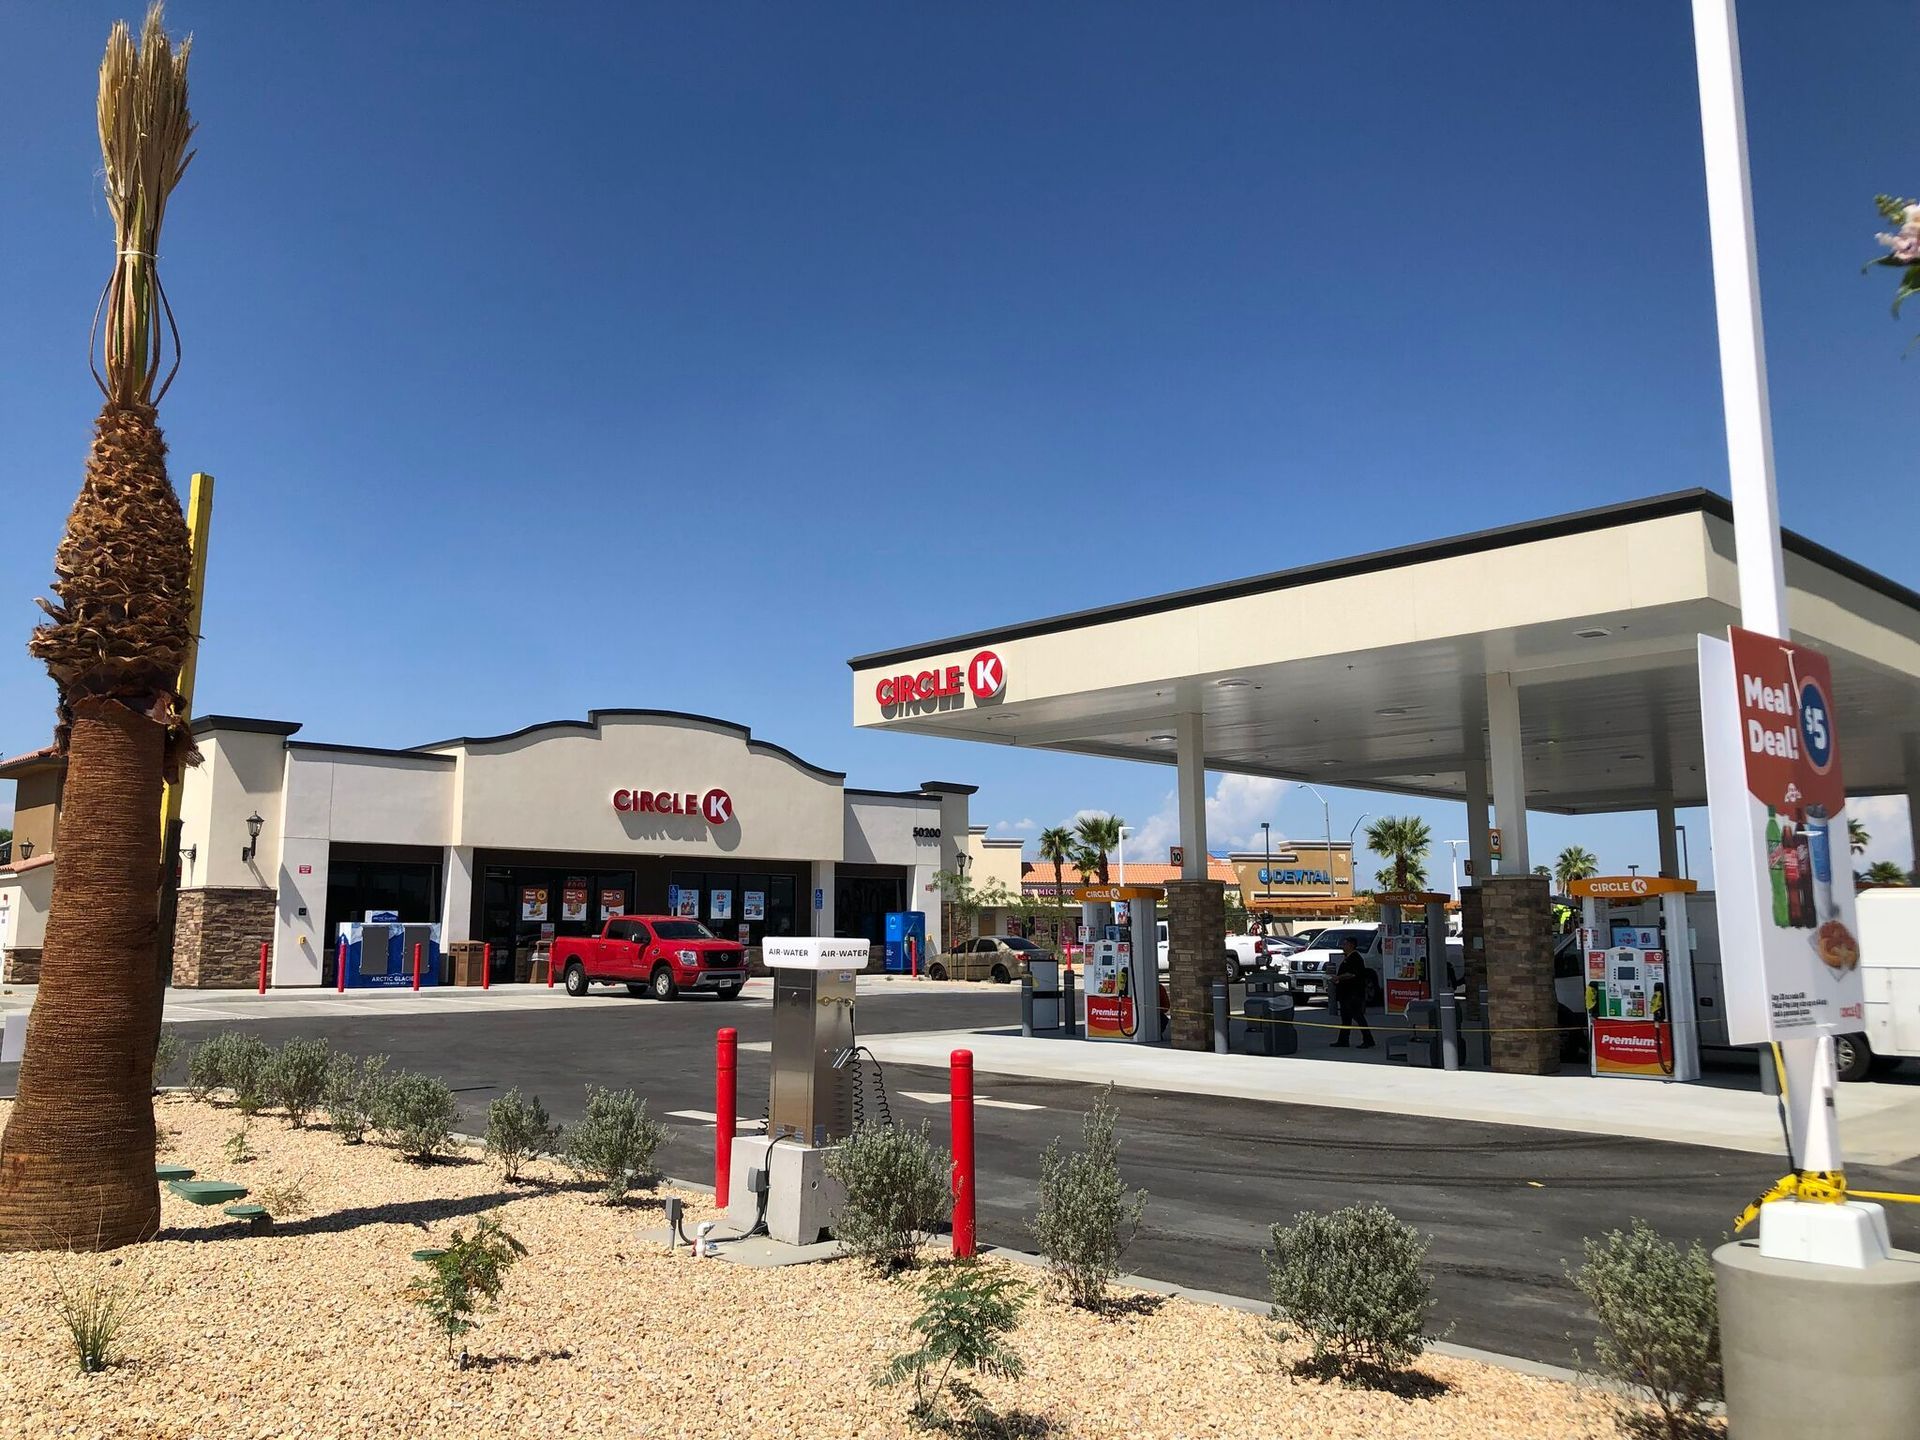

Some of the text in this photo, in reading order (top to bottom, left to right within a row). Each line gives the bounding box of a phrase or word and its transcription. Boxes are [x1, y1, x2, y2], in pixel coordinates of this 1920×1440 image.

[876, 666, 960, 705] CIRCLE
[1743, 674, 1793, 716] Meal
[1747, 719, 1800, 760] Deal!
[1804, 705, 1828, 750] $5
[613, 789, 698, 815] CIRCLE
[1172, 852, 1181, 862] 10
[1086, 890, 1110, 899] CIRCLE
[1590, 882, 1630, 892] CIRCLE
[768, 948, 808, 956] AIR-WATER
